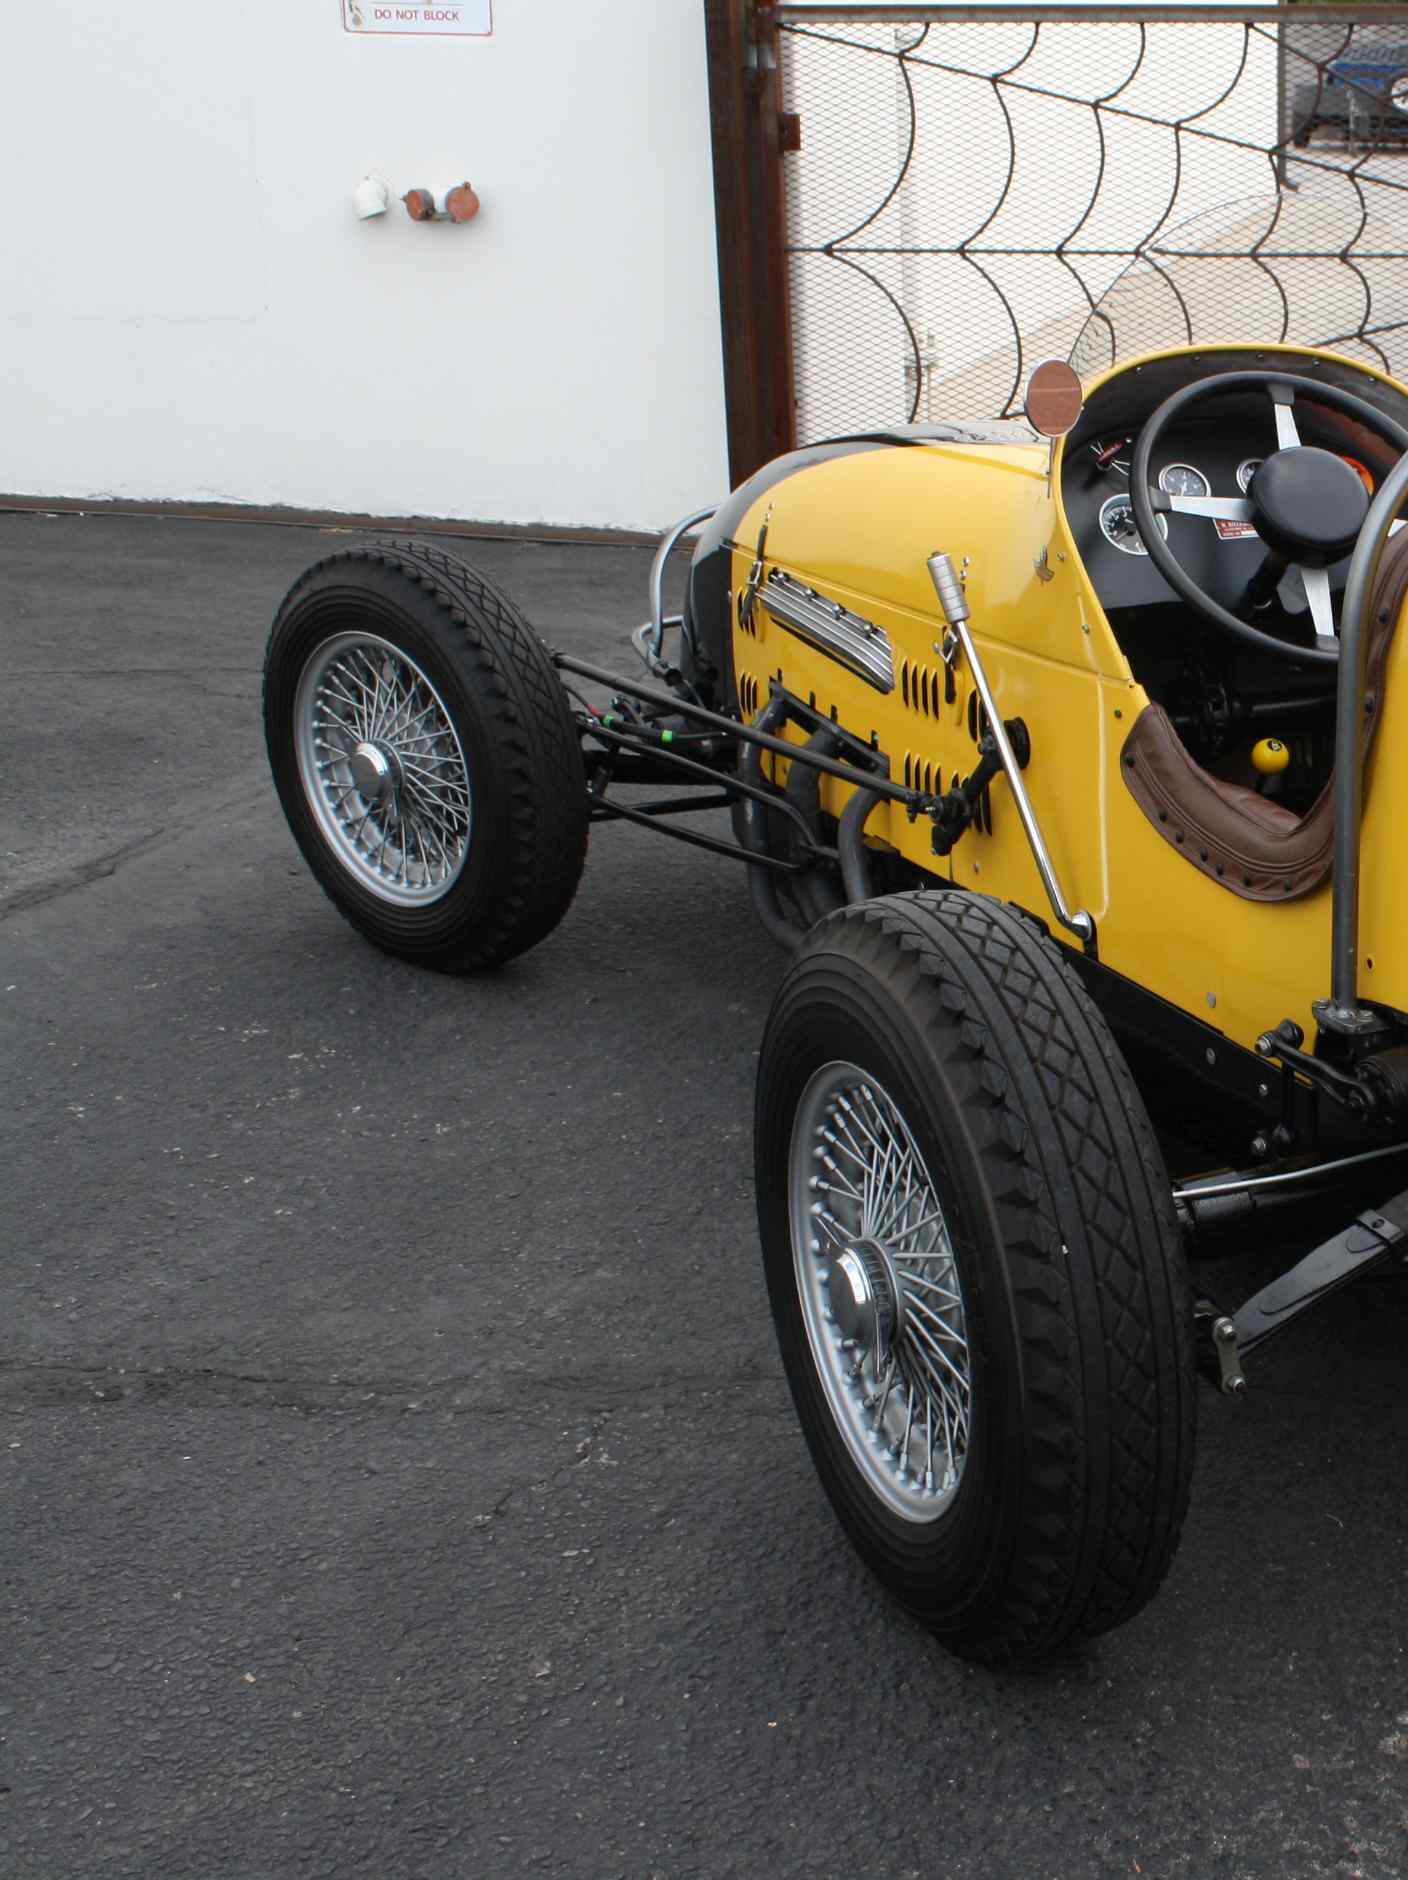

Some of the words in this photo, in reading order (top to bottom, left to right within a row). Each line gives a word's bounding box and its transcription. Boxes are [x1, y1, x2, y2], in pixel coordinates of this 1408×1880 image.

[374, 9, 392, 20] DO
[396, 9, 418, 20] NOT
[424, 10, 460, 21] BLOCK
